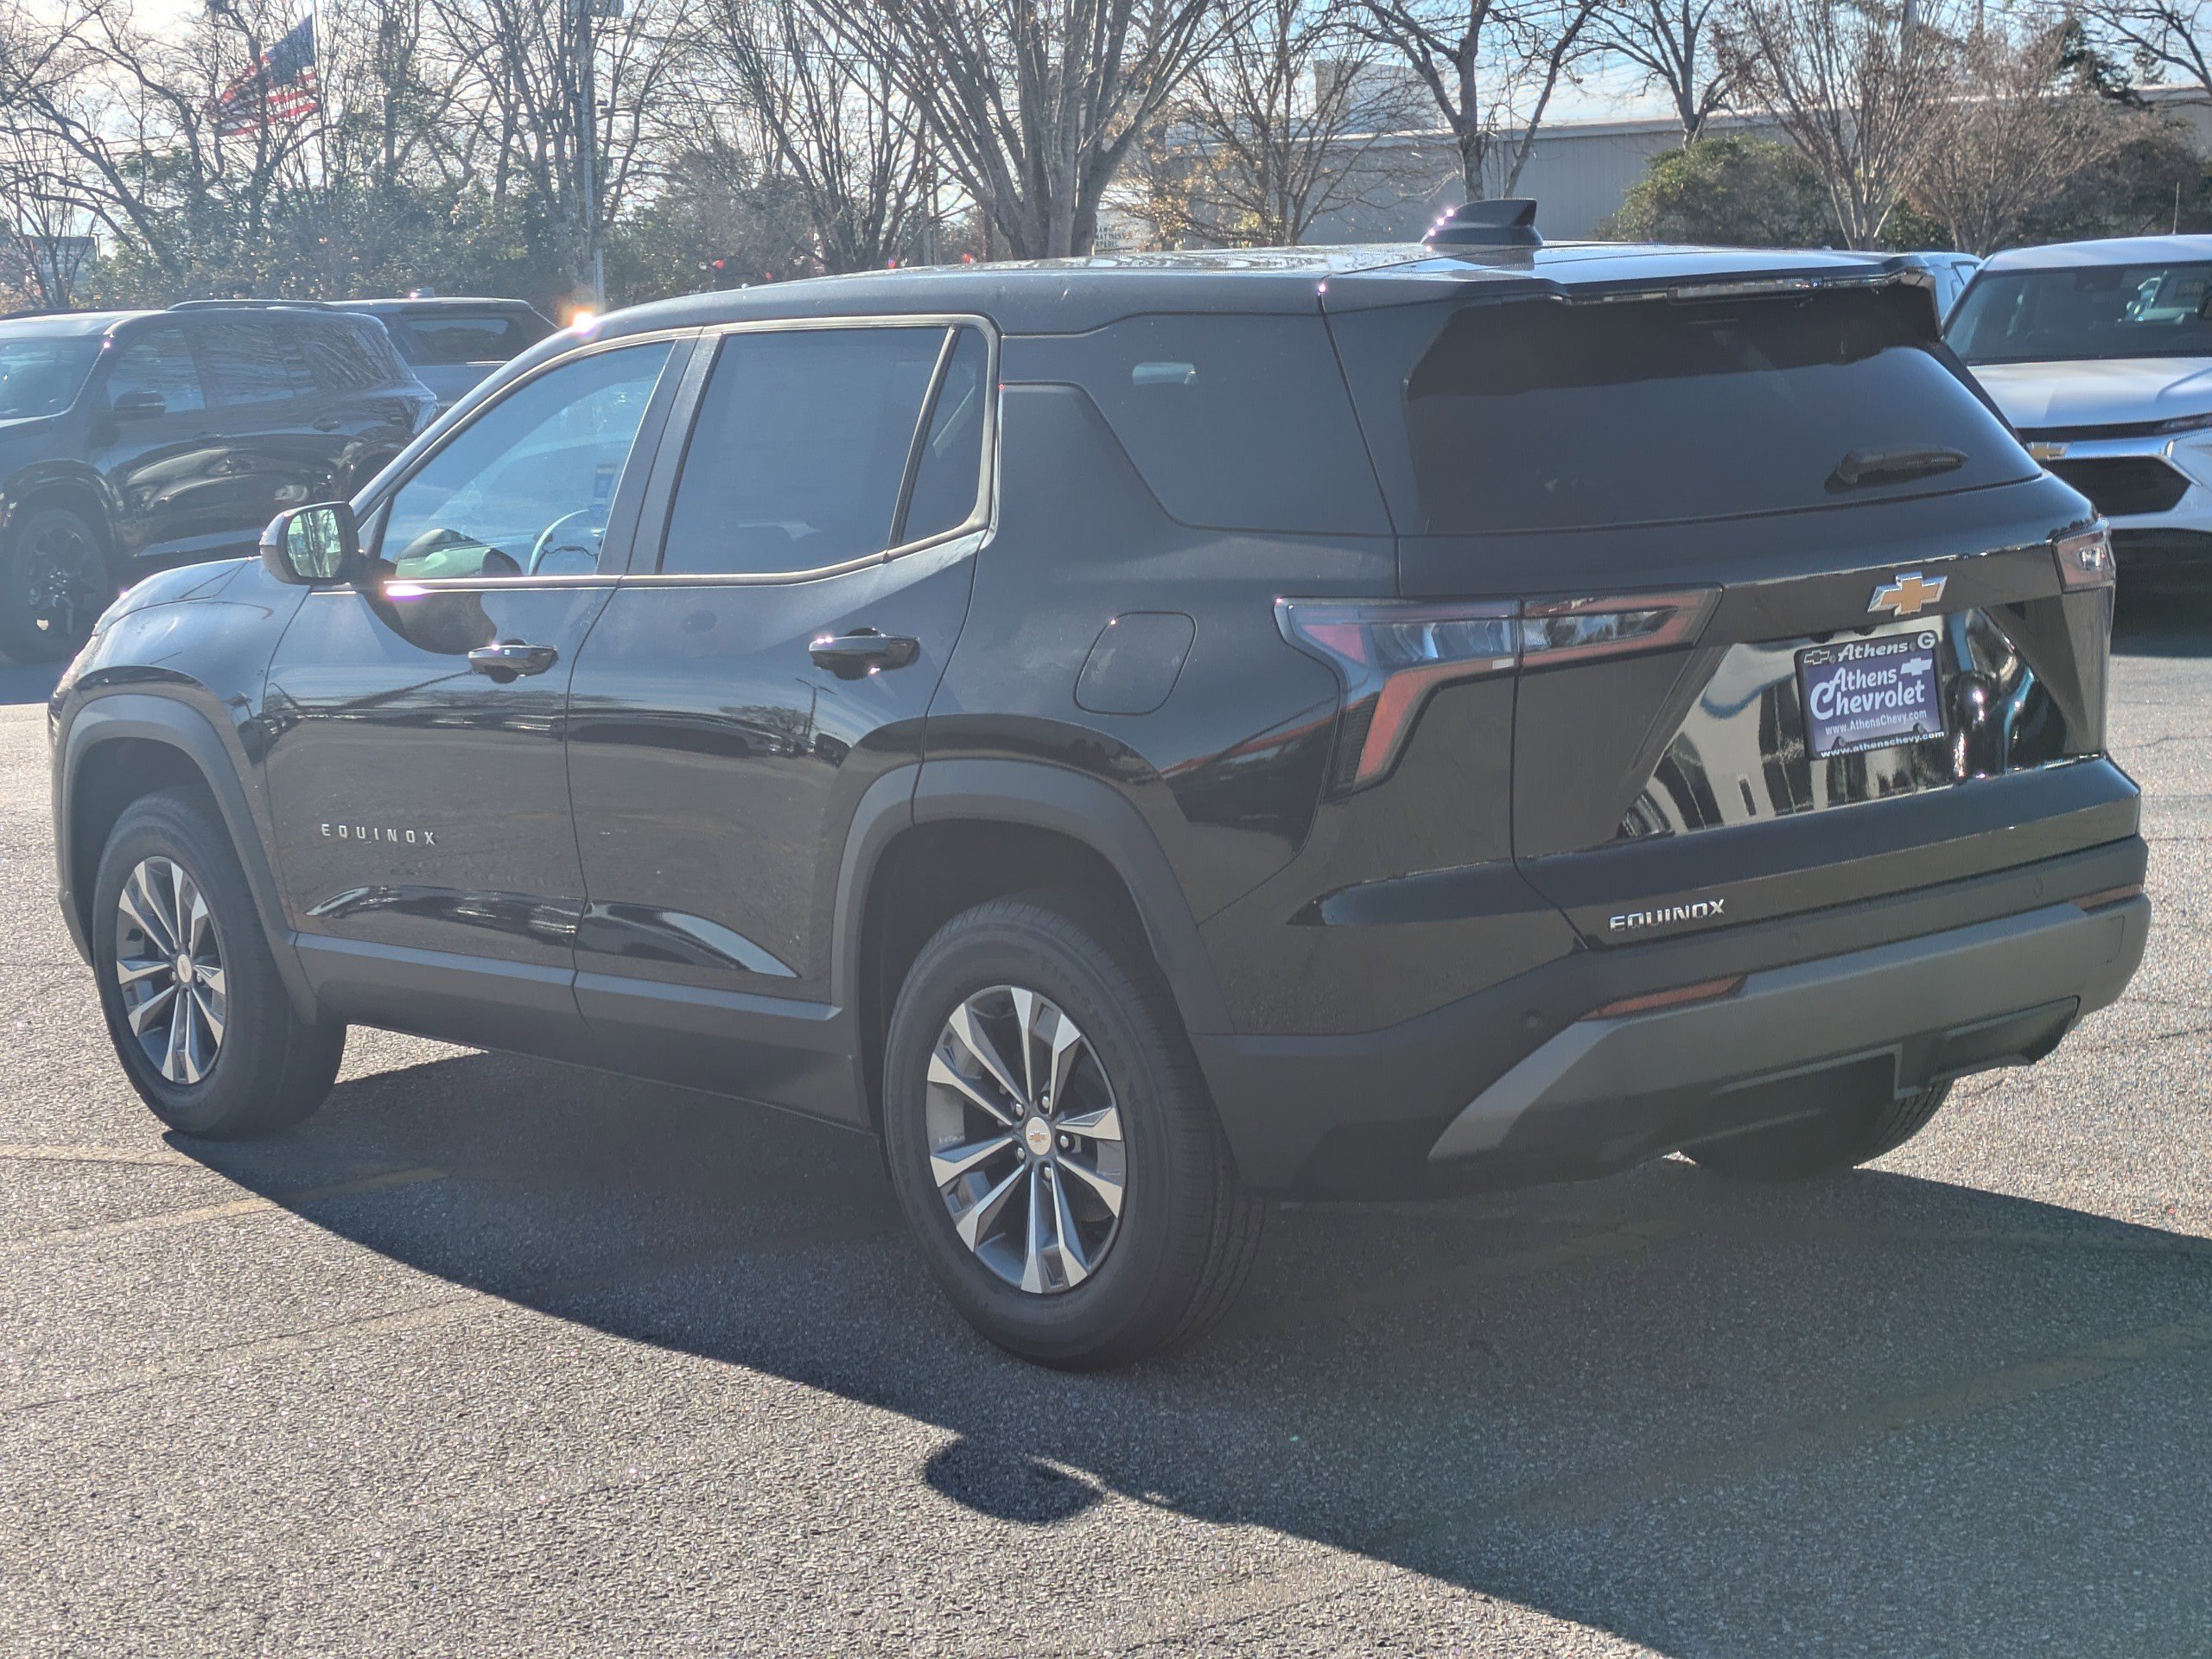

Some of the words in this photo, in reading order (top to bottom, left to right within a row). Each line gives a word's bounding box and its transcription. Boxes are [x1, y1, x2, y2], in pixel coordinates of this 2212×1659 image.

[1838, 641, 1909, 662] Athens
[1917, 632, 1936, 649] G
[1827, 667, 1897, 692] Athens
[1809, 679, 1925, 721] Chevrolet
[1825, 709, 1927, 735] www.AthensChevy.com
[1820, 730, 1945, 759] www.athenschevy.com
[321, 823, 435, 845] EQUINOX
[1610, 899, 1725, 931] EQUINOX
